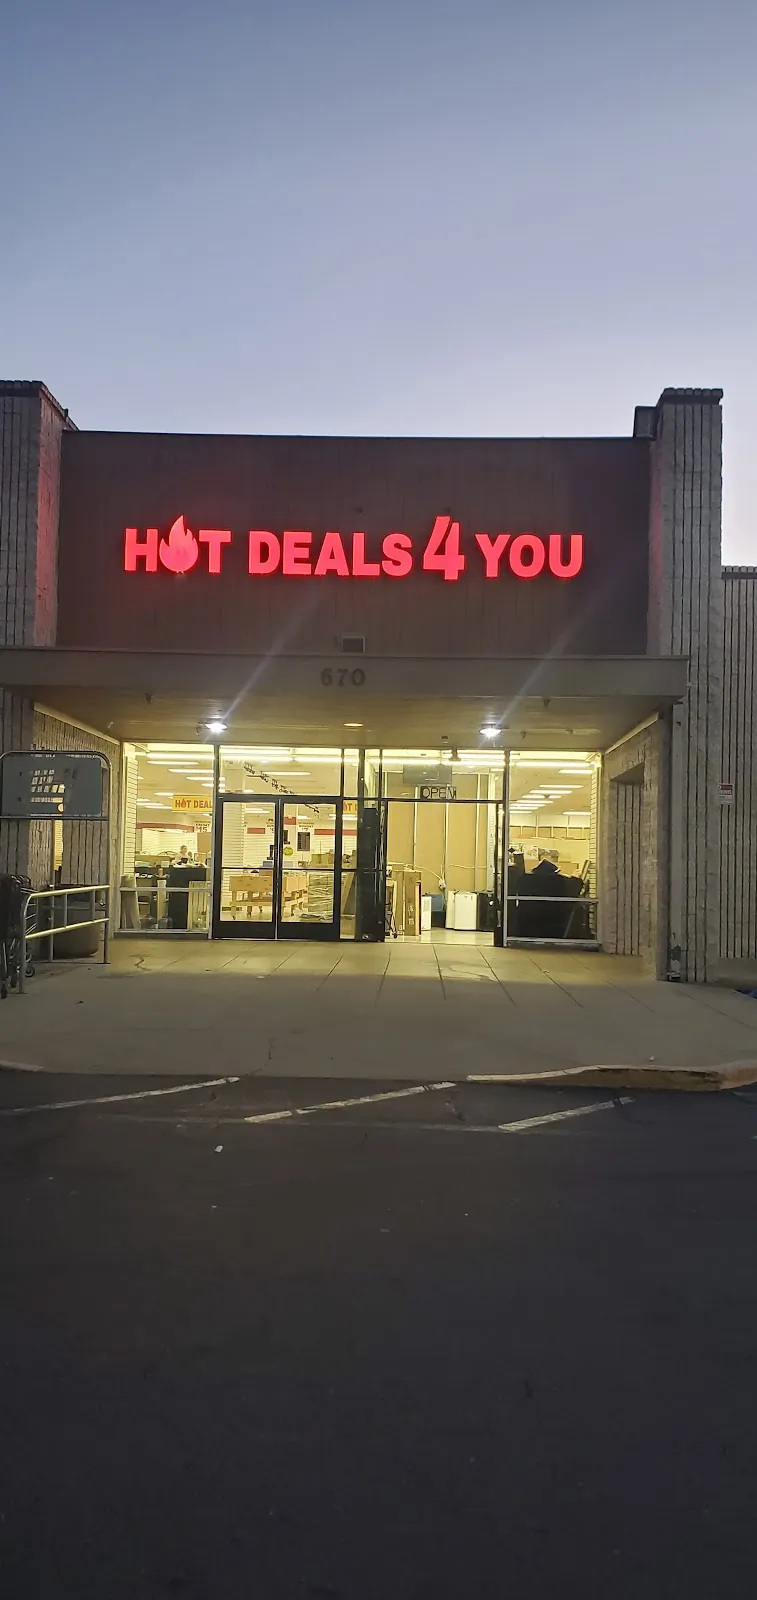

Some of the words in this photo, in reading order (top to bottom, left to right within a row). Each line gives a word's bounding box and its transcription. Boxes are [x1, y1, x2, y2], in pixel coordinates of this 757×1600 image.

[124, 515, 232, 574] HOT
[248, 530, 413, 577] DEALS
[422, 515, 465, 581] 4
[475, 534, 584, 578] YOU
[321, 668, 366, 687] 670
[421, 786, 456, 799] OPEN
